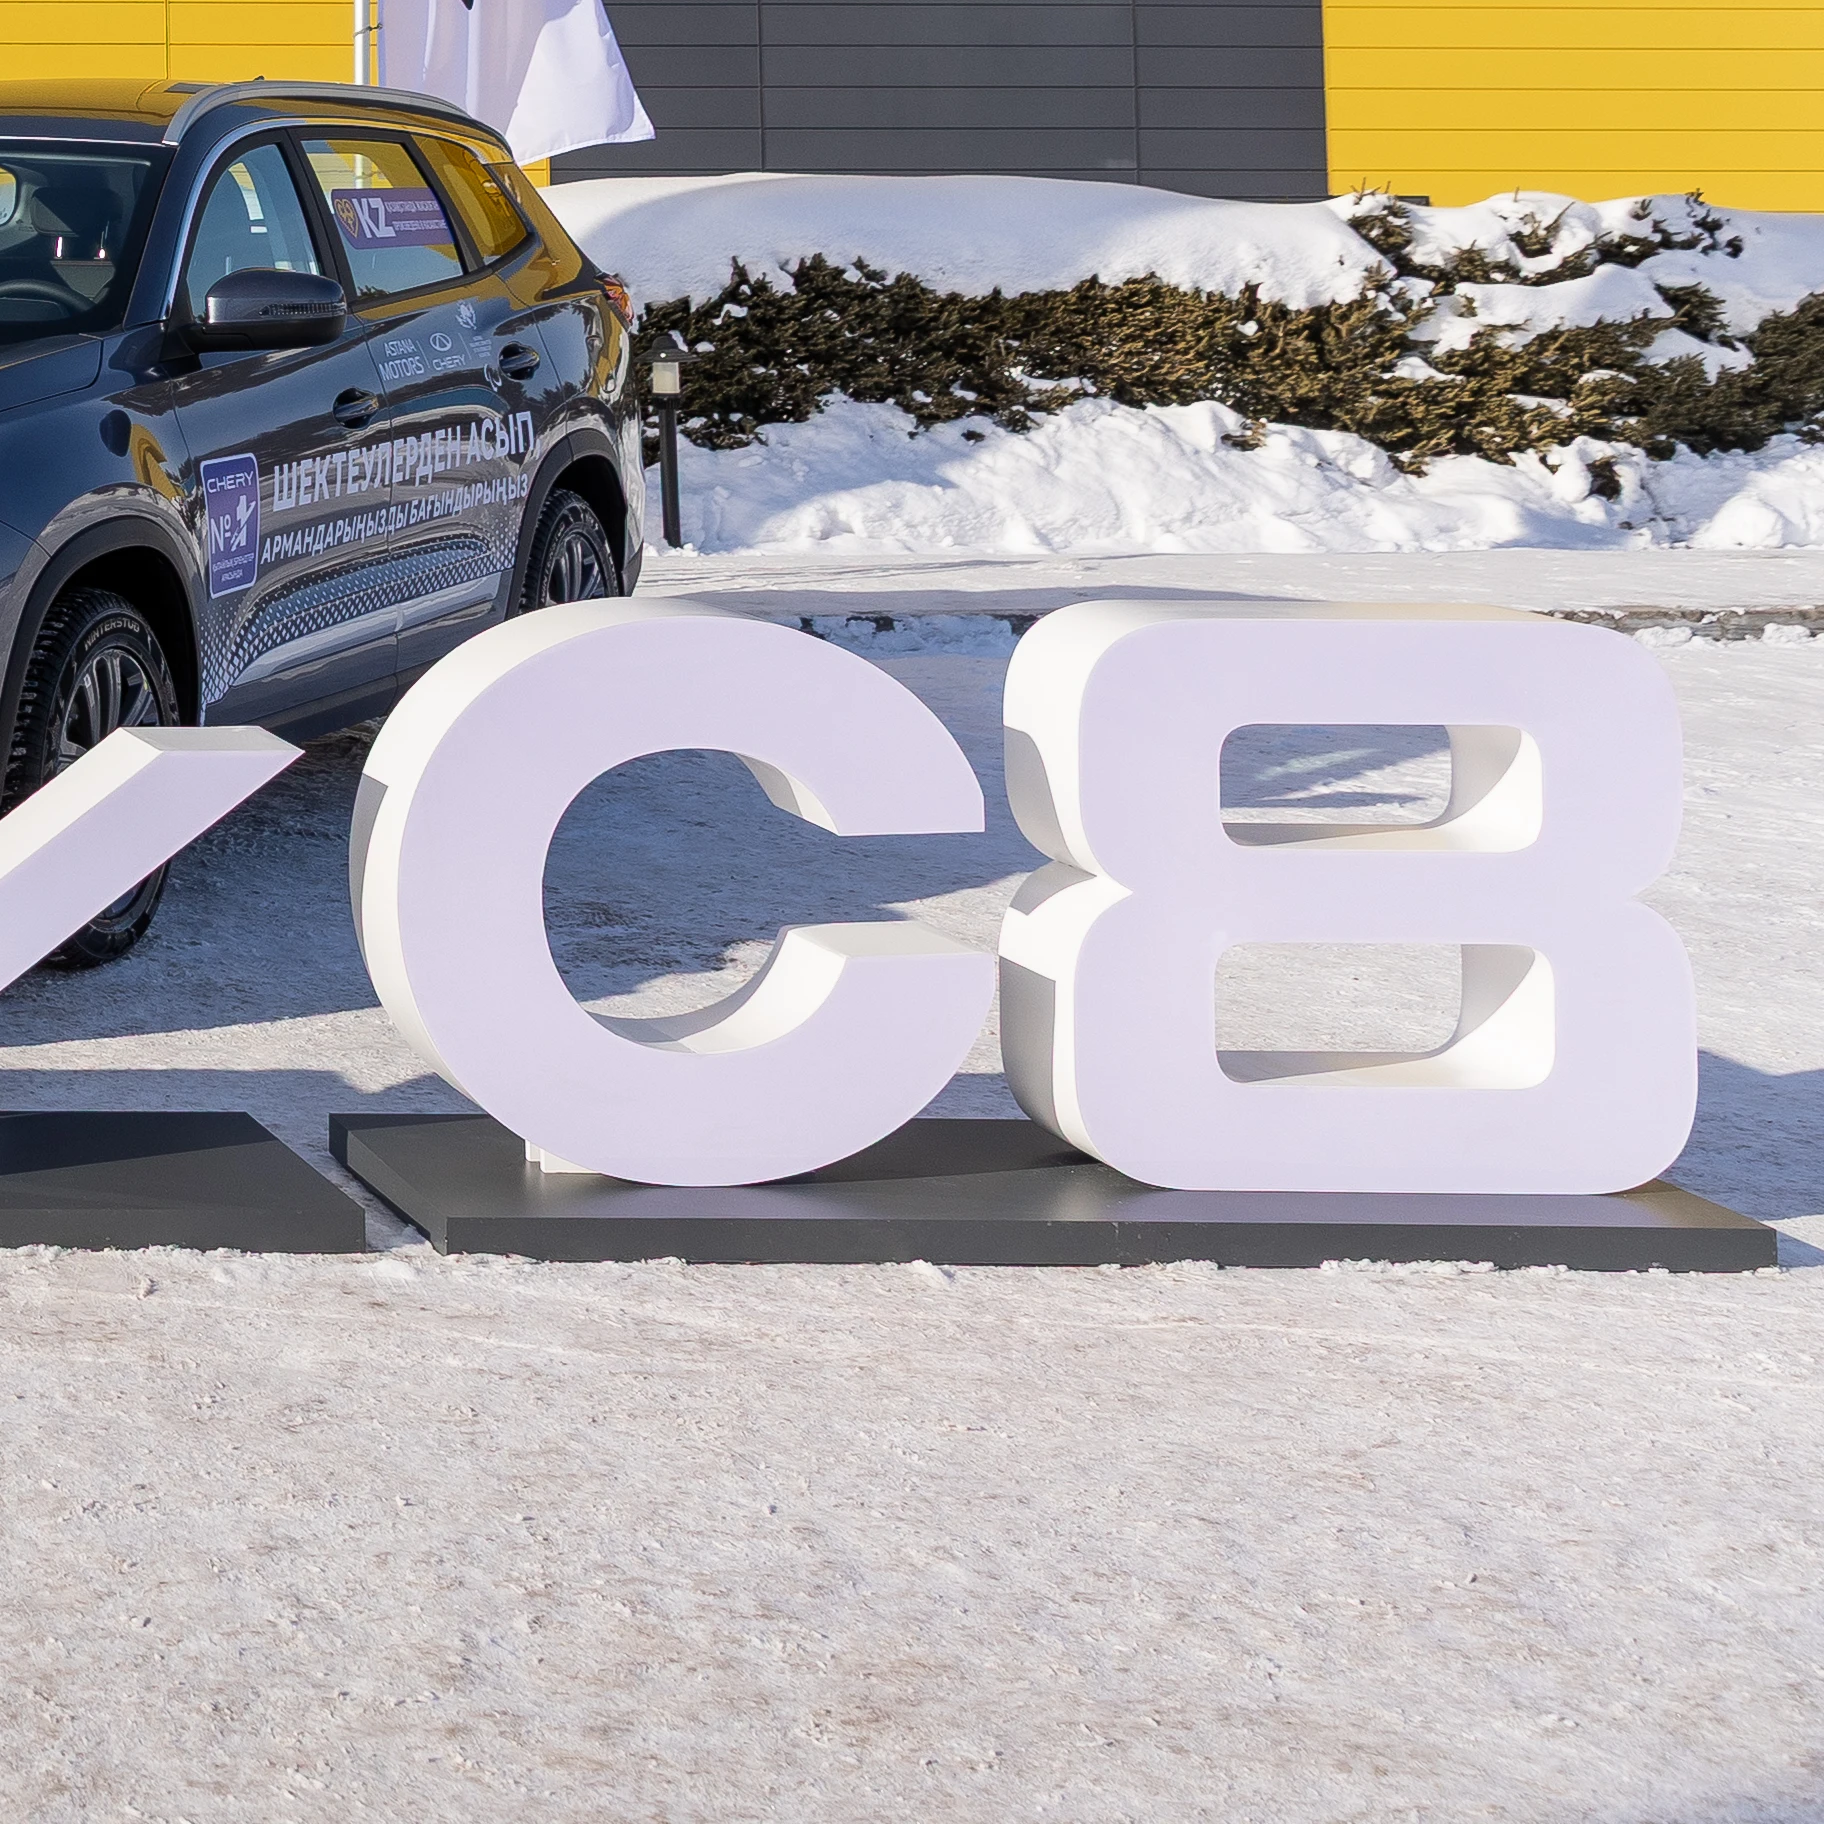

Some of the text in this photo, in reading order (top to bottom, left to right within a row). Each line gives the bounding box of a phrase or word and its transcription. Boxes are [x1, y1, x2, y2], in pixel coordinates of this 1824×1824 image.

[352, 198, 396, 238] KZ
[384, 338, 417, 357] ASTANA
[433, 354, 466, 370] CHERY
[379, 356, 424, 381] MOTORS
[273, 410, 542, 512] ШЕКТЕУЛЕРДЕН АСЫП,
[207, 471, 253, 494] CHERY
[261, 473, 528, 564] АРМАНДАРЫҢЫЗДЫ БАҒЫНДЫРЫҢЫЗ
[351, 596, 1698, 1195] C8
